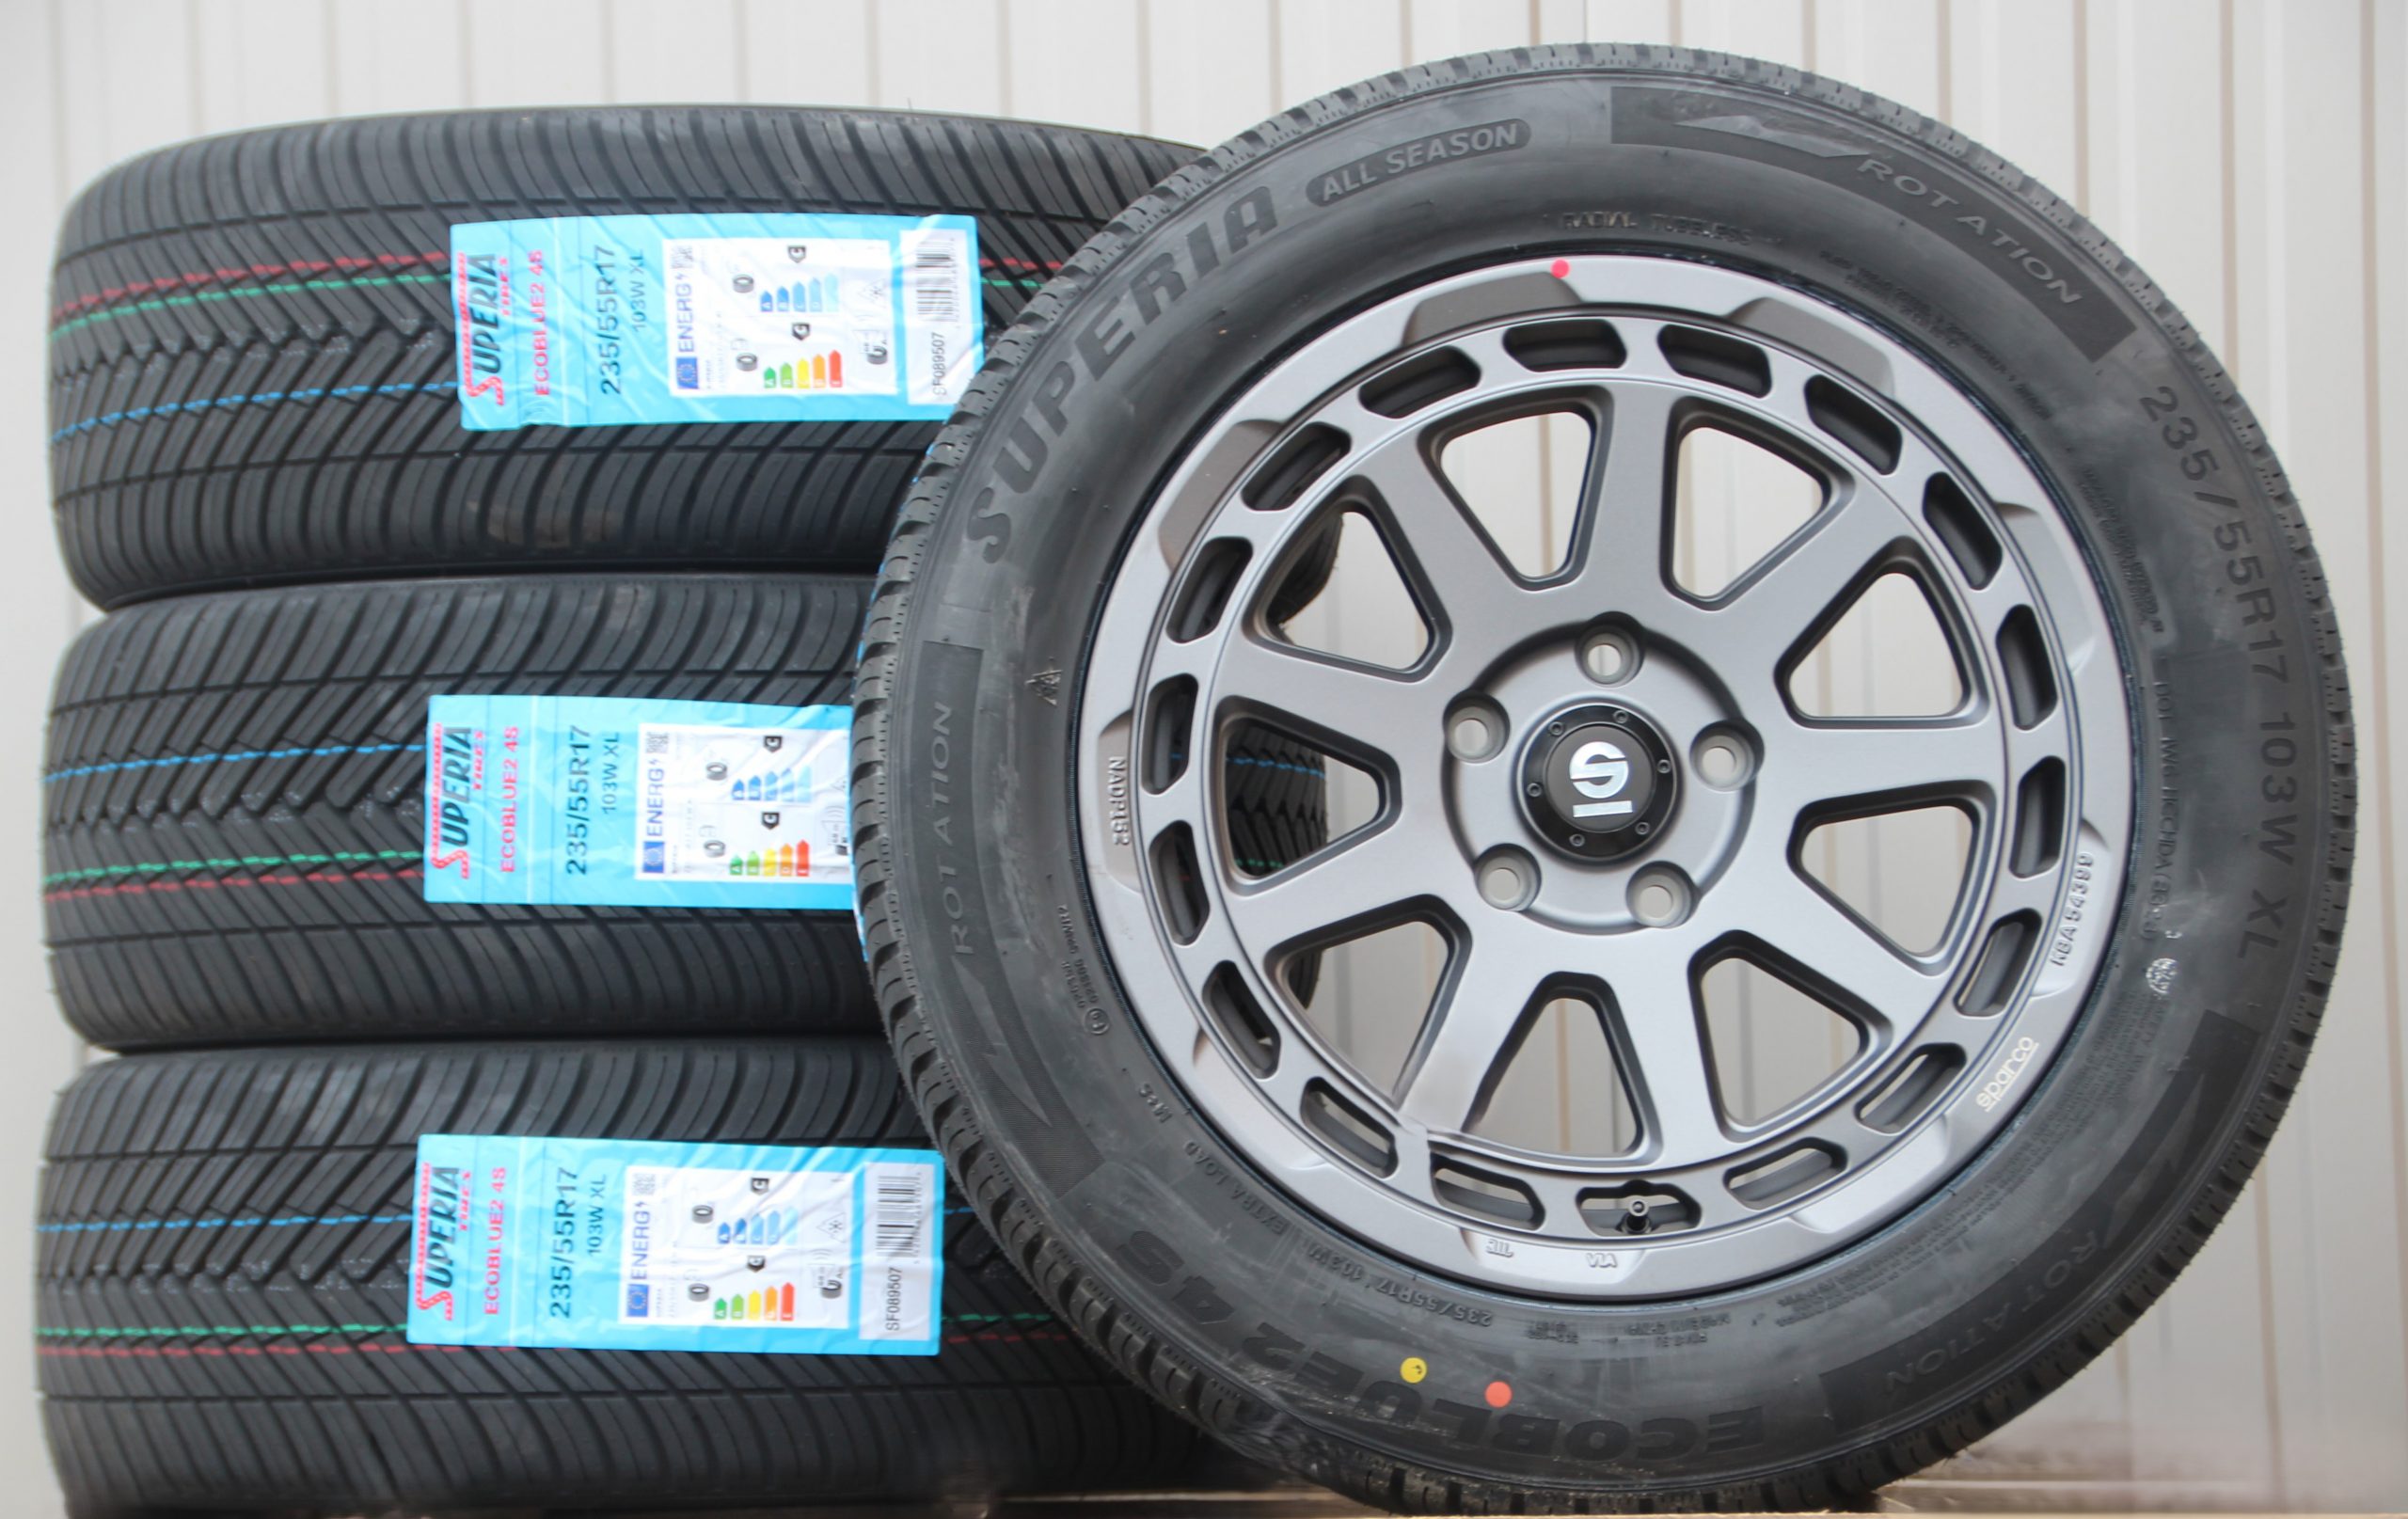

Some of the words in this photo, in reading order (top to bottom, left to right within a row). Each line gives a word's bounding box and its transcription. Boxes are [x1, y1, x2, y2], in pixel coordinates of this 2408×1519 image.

[1322, 163, 1369, 201] ALL
[1386, 122, 1518, 176] SEASON
[528, 250, 545, 277] 4S
[628, 249, 644, 274] XL
[457, 252, 503, 406] SUPERIA
[531, 283, 550, 396] ECOBLUE2
[594, 245, 621, 395] 235/55R17
[630, 279, 647, 332] 103W
[676, 283, 695, 353] ENERG
[966, 186, 1277, 564] SUPERIA
[2139, 385, 2291, 682] 235/55R17
[503, 726, 518, 753] 4S
[603, 732, 619, 756] XL
[431, 722, 471, 878] SUPERIA
[500, 758, 518, 872] ECOBLUE2
[565, 725, 591, 875] 235/55R17
[601, 764, 619, 815] 103W
[647, 768, 664, 837] ENERG
[2259, 711, 2301, 866] 103W
[2050, 926, 2078, 967] KBA
[2238, 889, 2290, 958] XL
[1975, 1036, 2038, 1112] sparco
[490, 1167, 505, 1193] 4S
[589, 1174, 607, 1199] XL
[1182, 1139, 1228, 1187] LOAD
[416, 1162, 459, 1321] SUPERIA
[550, 1167, 578, 1319] 235/55R17
[586, 1207, 604, 1257] 103W
[630, 1209, 649, 1281] ENERG
[1229, 1184, 1285, 1236] EXTRA
[484, 1199, 503, 1315] ECOBLUE2
[1125, 1229, 1234, 1324] 4S
[1586, 1252, 1618, 1269] VIA
[885, 1267, 902, 1331] SF089507
[1378, 1279, 1494, 1328] 235/55R17
[1241, 1322, 1766, 1461] ECOBLUE2
